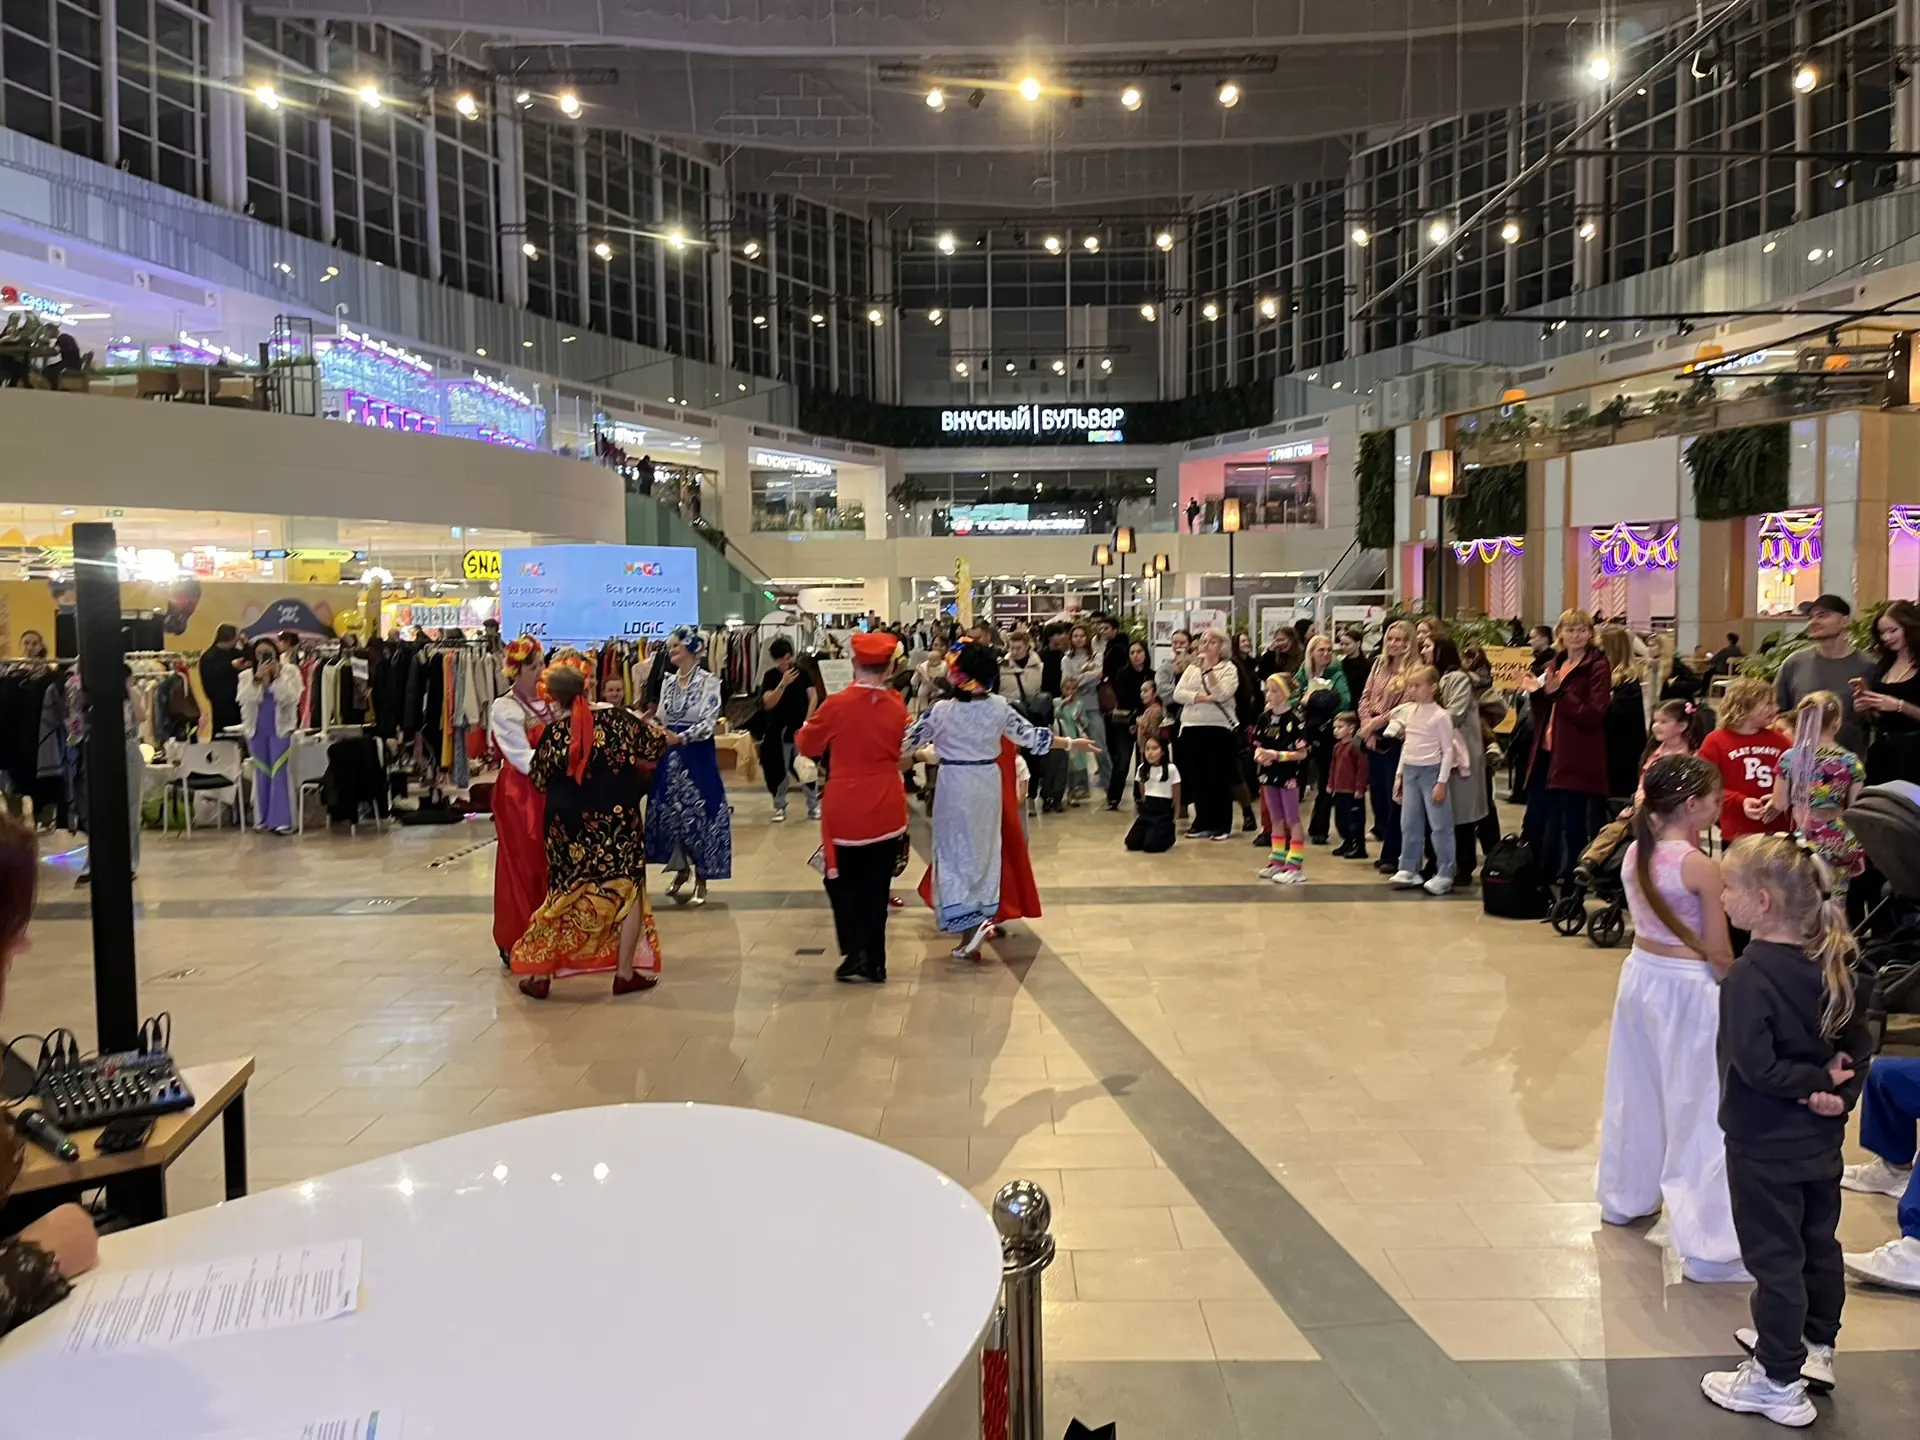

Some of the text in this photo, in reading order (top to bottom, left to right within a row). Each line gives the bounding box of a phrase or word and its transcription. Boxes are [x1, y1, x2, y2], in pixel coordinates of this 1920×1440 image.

[941, 404, 1030, 431] ВКУСНЫЙ
[605, 584, 624, 594] Все
[611, 599, 677, 608] возможности
[1743, 757, 1774, 788] PS
